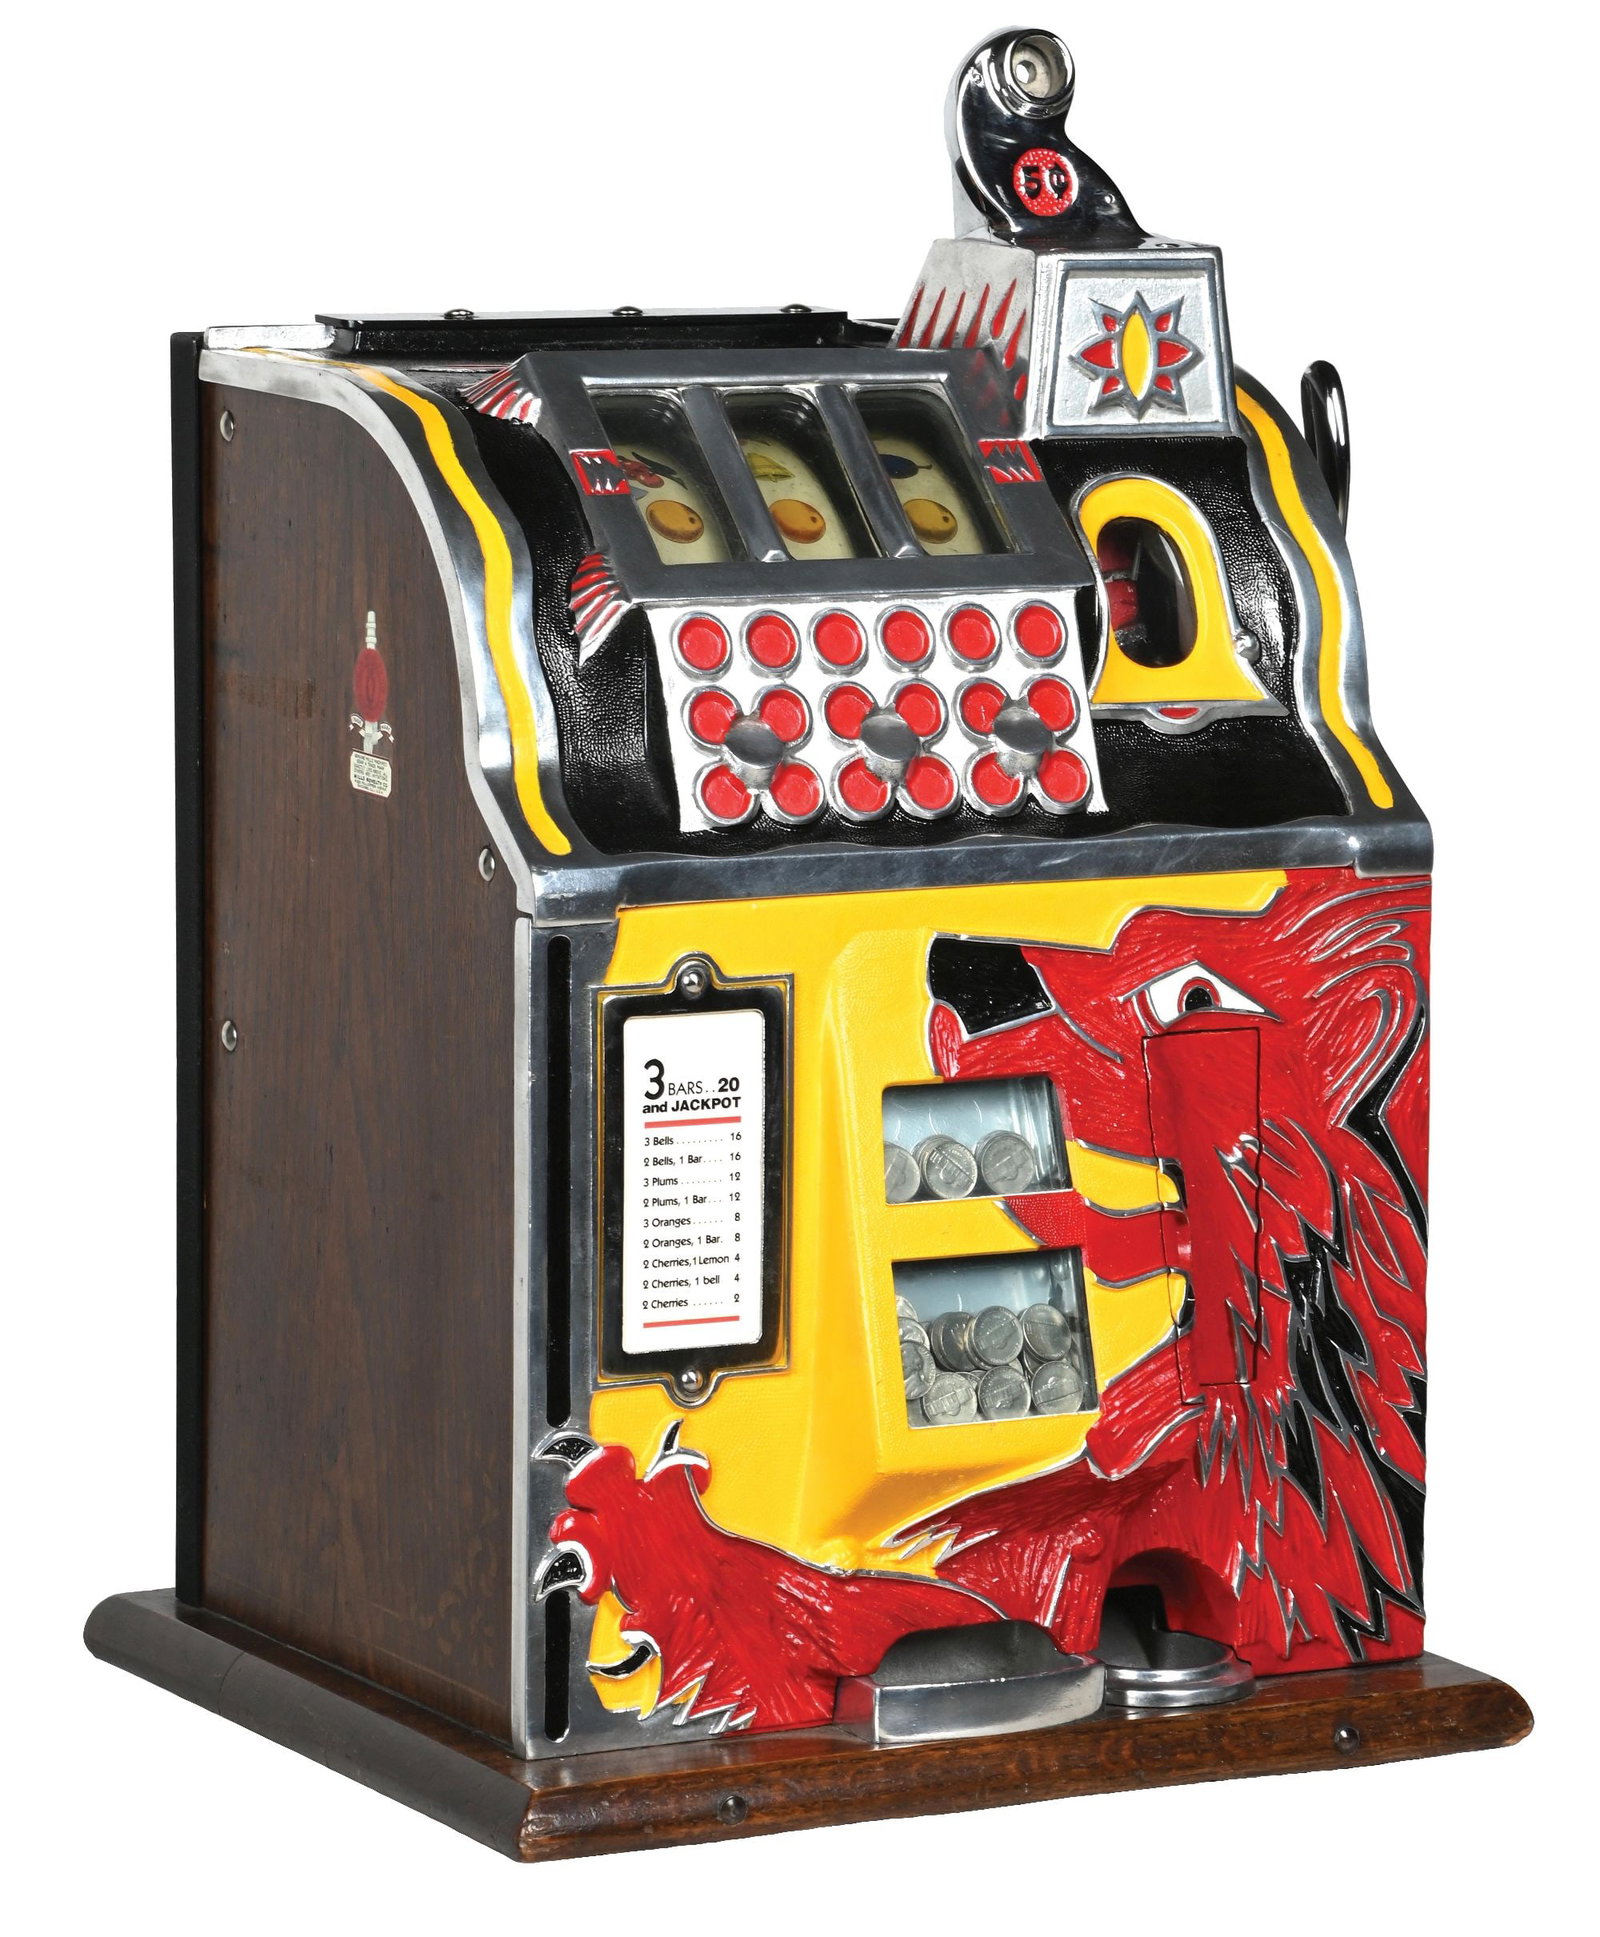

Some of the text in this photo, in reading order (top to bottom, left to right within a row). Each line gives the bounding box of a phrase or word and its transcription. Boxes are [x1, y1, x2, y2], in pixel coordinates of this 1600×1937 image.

[643, 1058, 665, 1101] 3
[717, 1077, 740, 1093] 20
[642, 1096, 742, 1114] and JACKPOT
[644, 1137, 651, 1147] 3
[730, 1132, 742, 1141] 16
[643, 1157, 650, 1167] 2
[652, 1156, 676, 1167] Bells,
[679, 1155, 684, 1164] 1
[730, 1152, 742, 1161] 16
[643, 1177, 650, 1187] 3
[729, 1171, 741, 1181] 12
[643, 1198, 650, 1208] 2
[652, 1197, 681, 1207] Plums,
[684, 1196, 689, 1205] 1
[729, 1192, 741, 1202] 12
[643, 1218, 650, 1228] 3
[734, 1212, 741, 1222] 8
[643, 1239, 650, 1249] 2
[652, 1237, 694, 1249] Oranges,
[697, 1236, 702, 1245] 1
[734, 1232, 741, 1242] 8
[643, 1259, 650, 1269] 2
[651, 1257, 692, 1268] Cherries,
[698, 1255, 730, 1265] Lemon
[734, 1253, 741, 1262] 4
[642, 1273, 740, 1290] 2 Cherries, 1 bell 4
[642, 1293, 740, 1310] 2 Cherries 2
